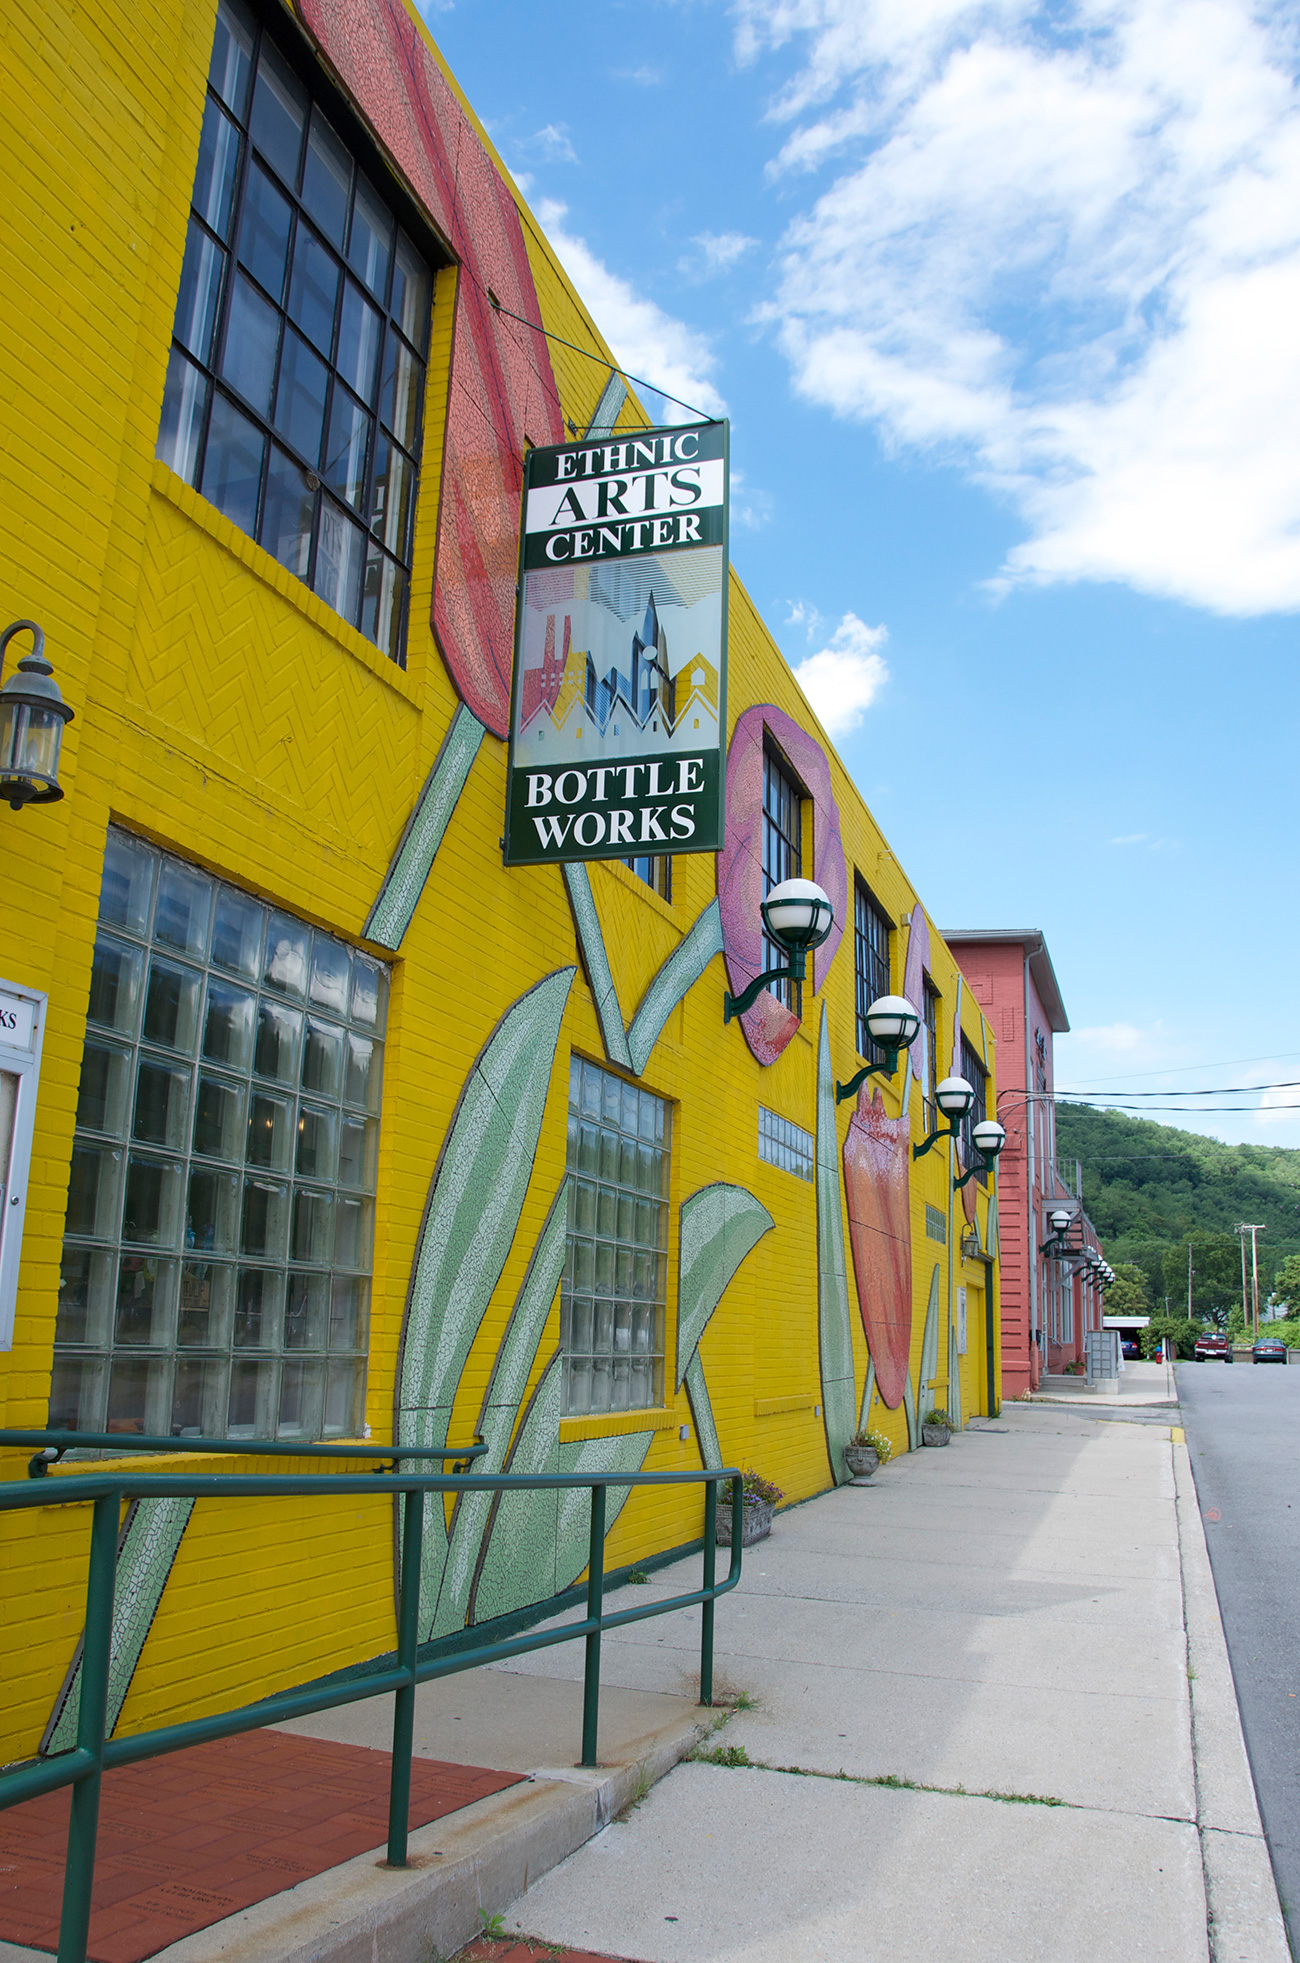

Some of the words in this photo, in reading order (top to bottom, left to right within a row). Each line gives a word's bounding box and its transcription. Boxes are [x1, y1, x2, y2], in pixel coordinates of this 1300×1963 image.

[554, 432, 699, 481] ETHNIC
[549, 467, 702, 526] ARTS
[545, 514, 702, 562] CENTER
[524, 758, 705, 808] BOTTLE
[532, 804, 695, 850] WORKS
